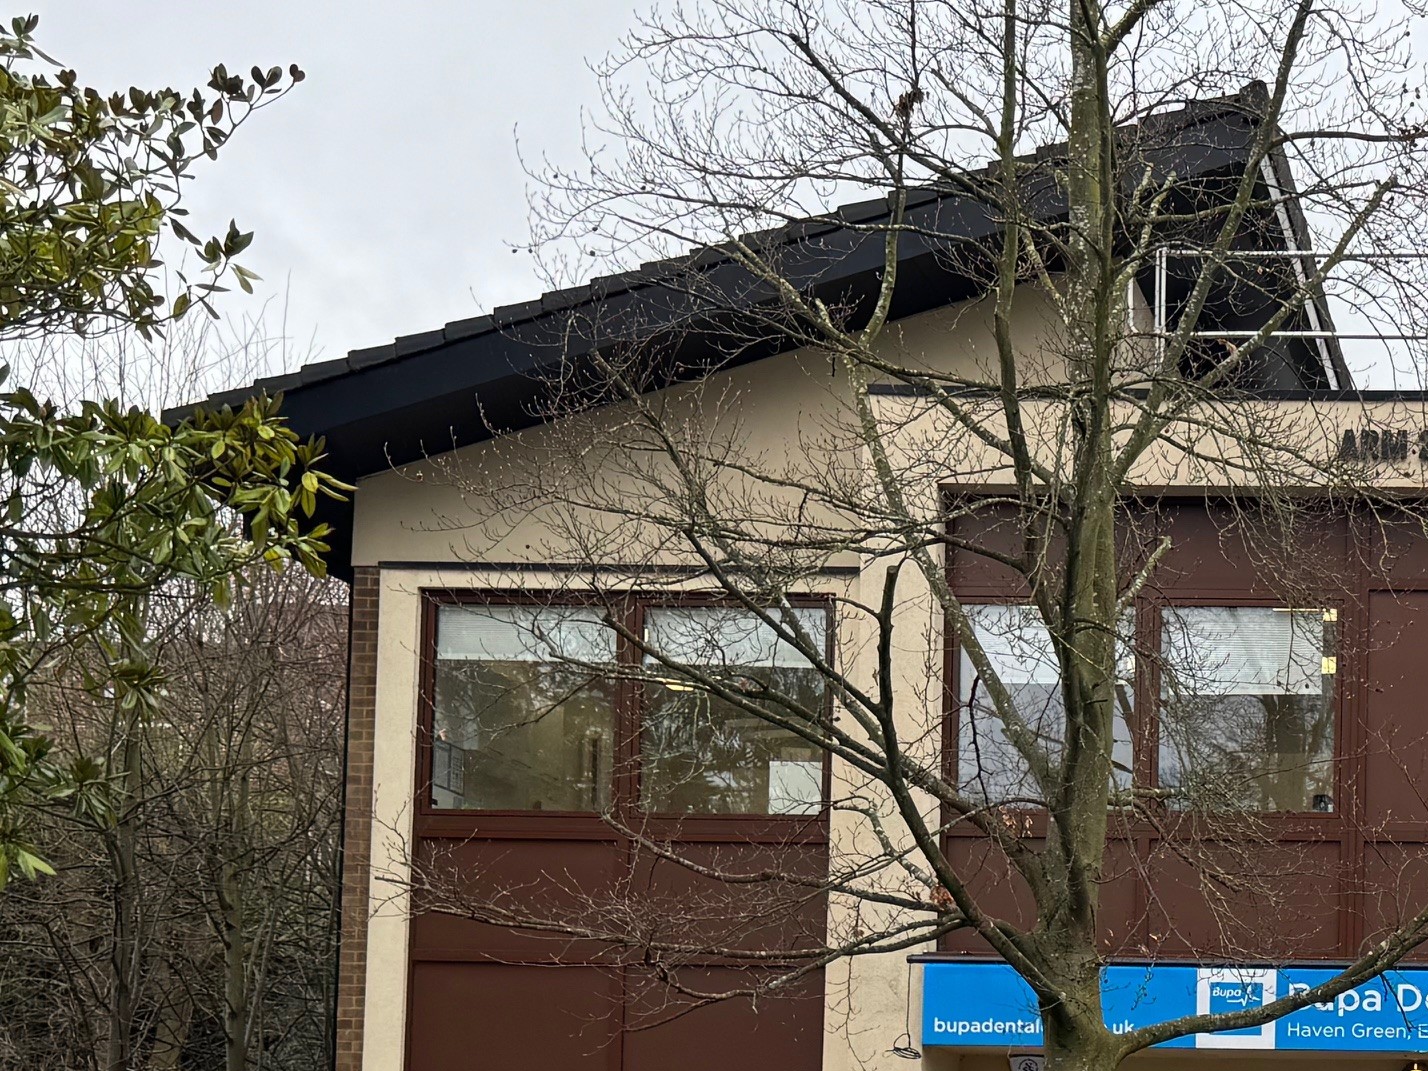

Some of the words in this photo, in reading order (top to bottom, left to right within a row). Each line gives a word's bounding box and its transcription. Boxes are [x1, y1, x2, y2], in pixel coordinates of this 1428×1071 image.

[1212, 986, 1242, 998] Bupa
[1287, 1023, 1345, 1037] Haven
[1351, 1023, 1412, 1040] Green,
